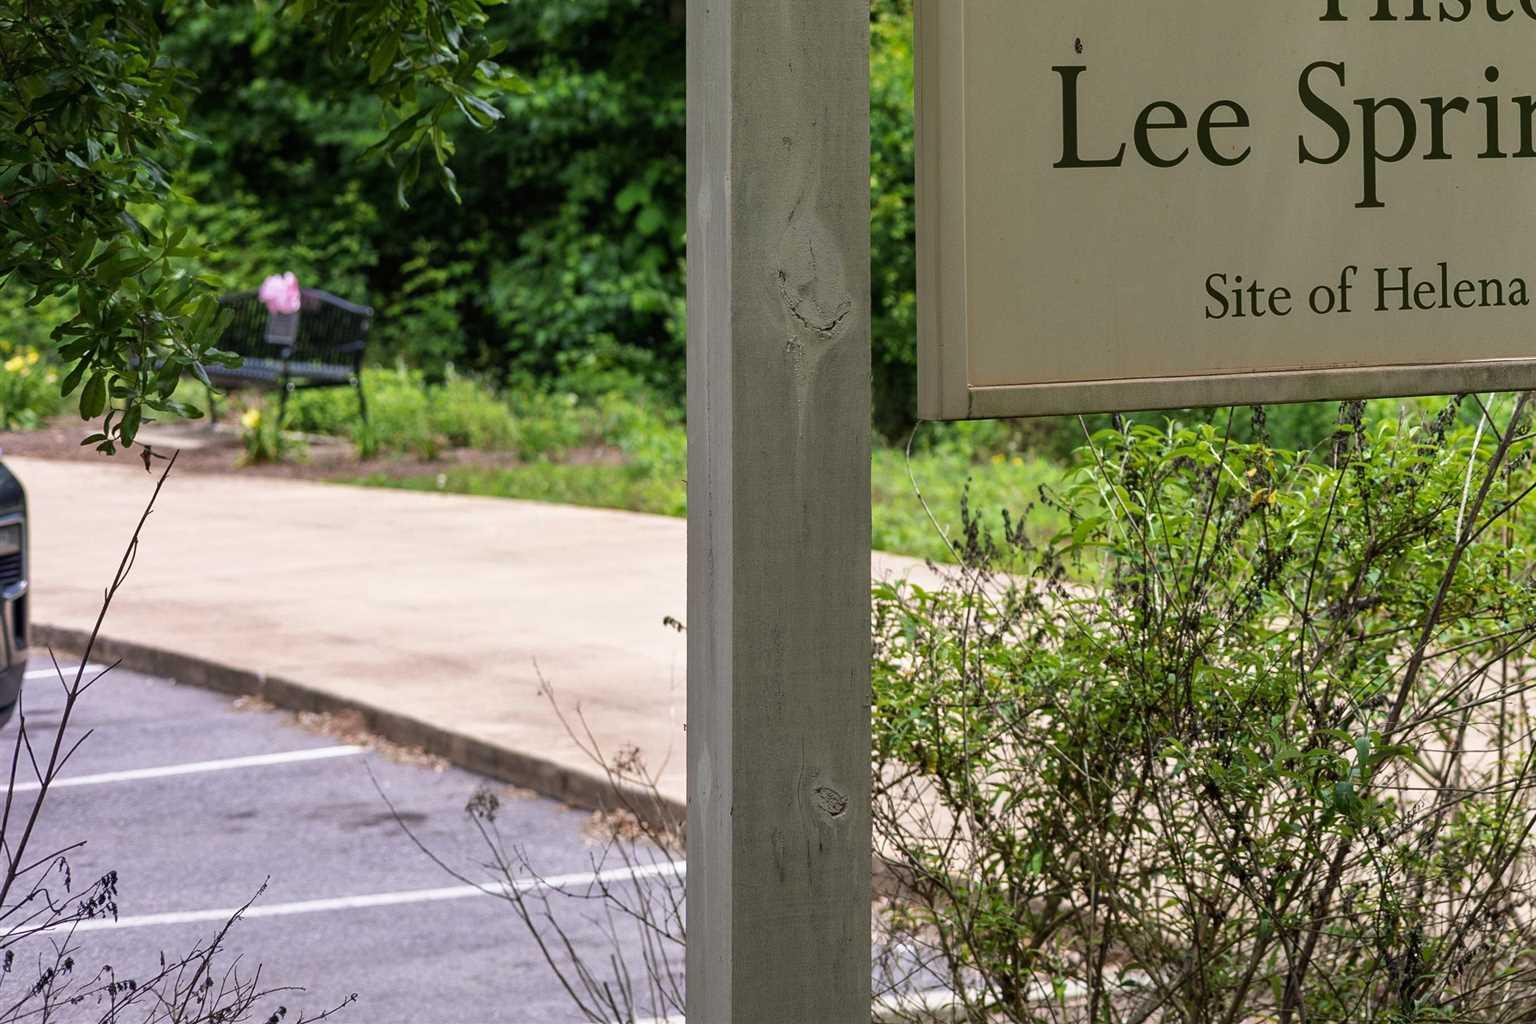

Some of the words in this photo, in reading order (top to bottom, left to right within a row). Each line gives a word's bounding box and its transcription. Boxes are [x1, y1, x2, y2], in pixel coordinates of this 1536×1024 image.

[1052, 65, 1251, 168] Lee
[1206, 273, 1292, 319] Site
[1309, 265, 1357, 314] of
[1374, 262, 1529, 311] Helena
